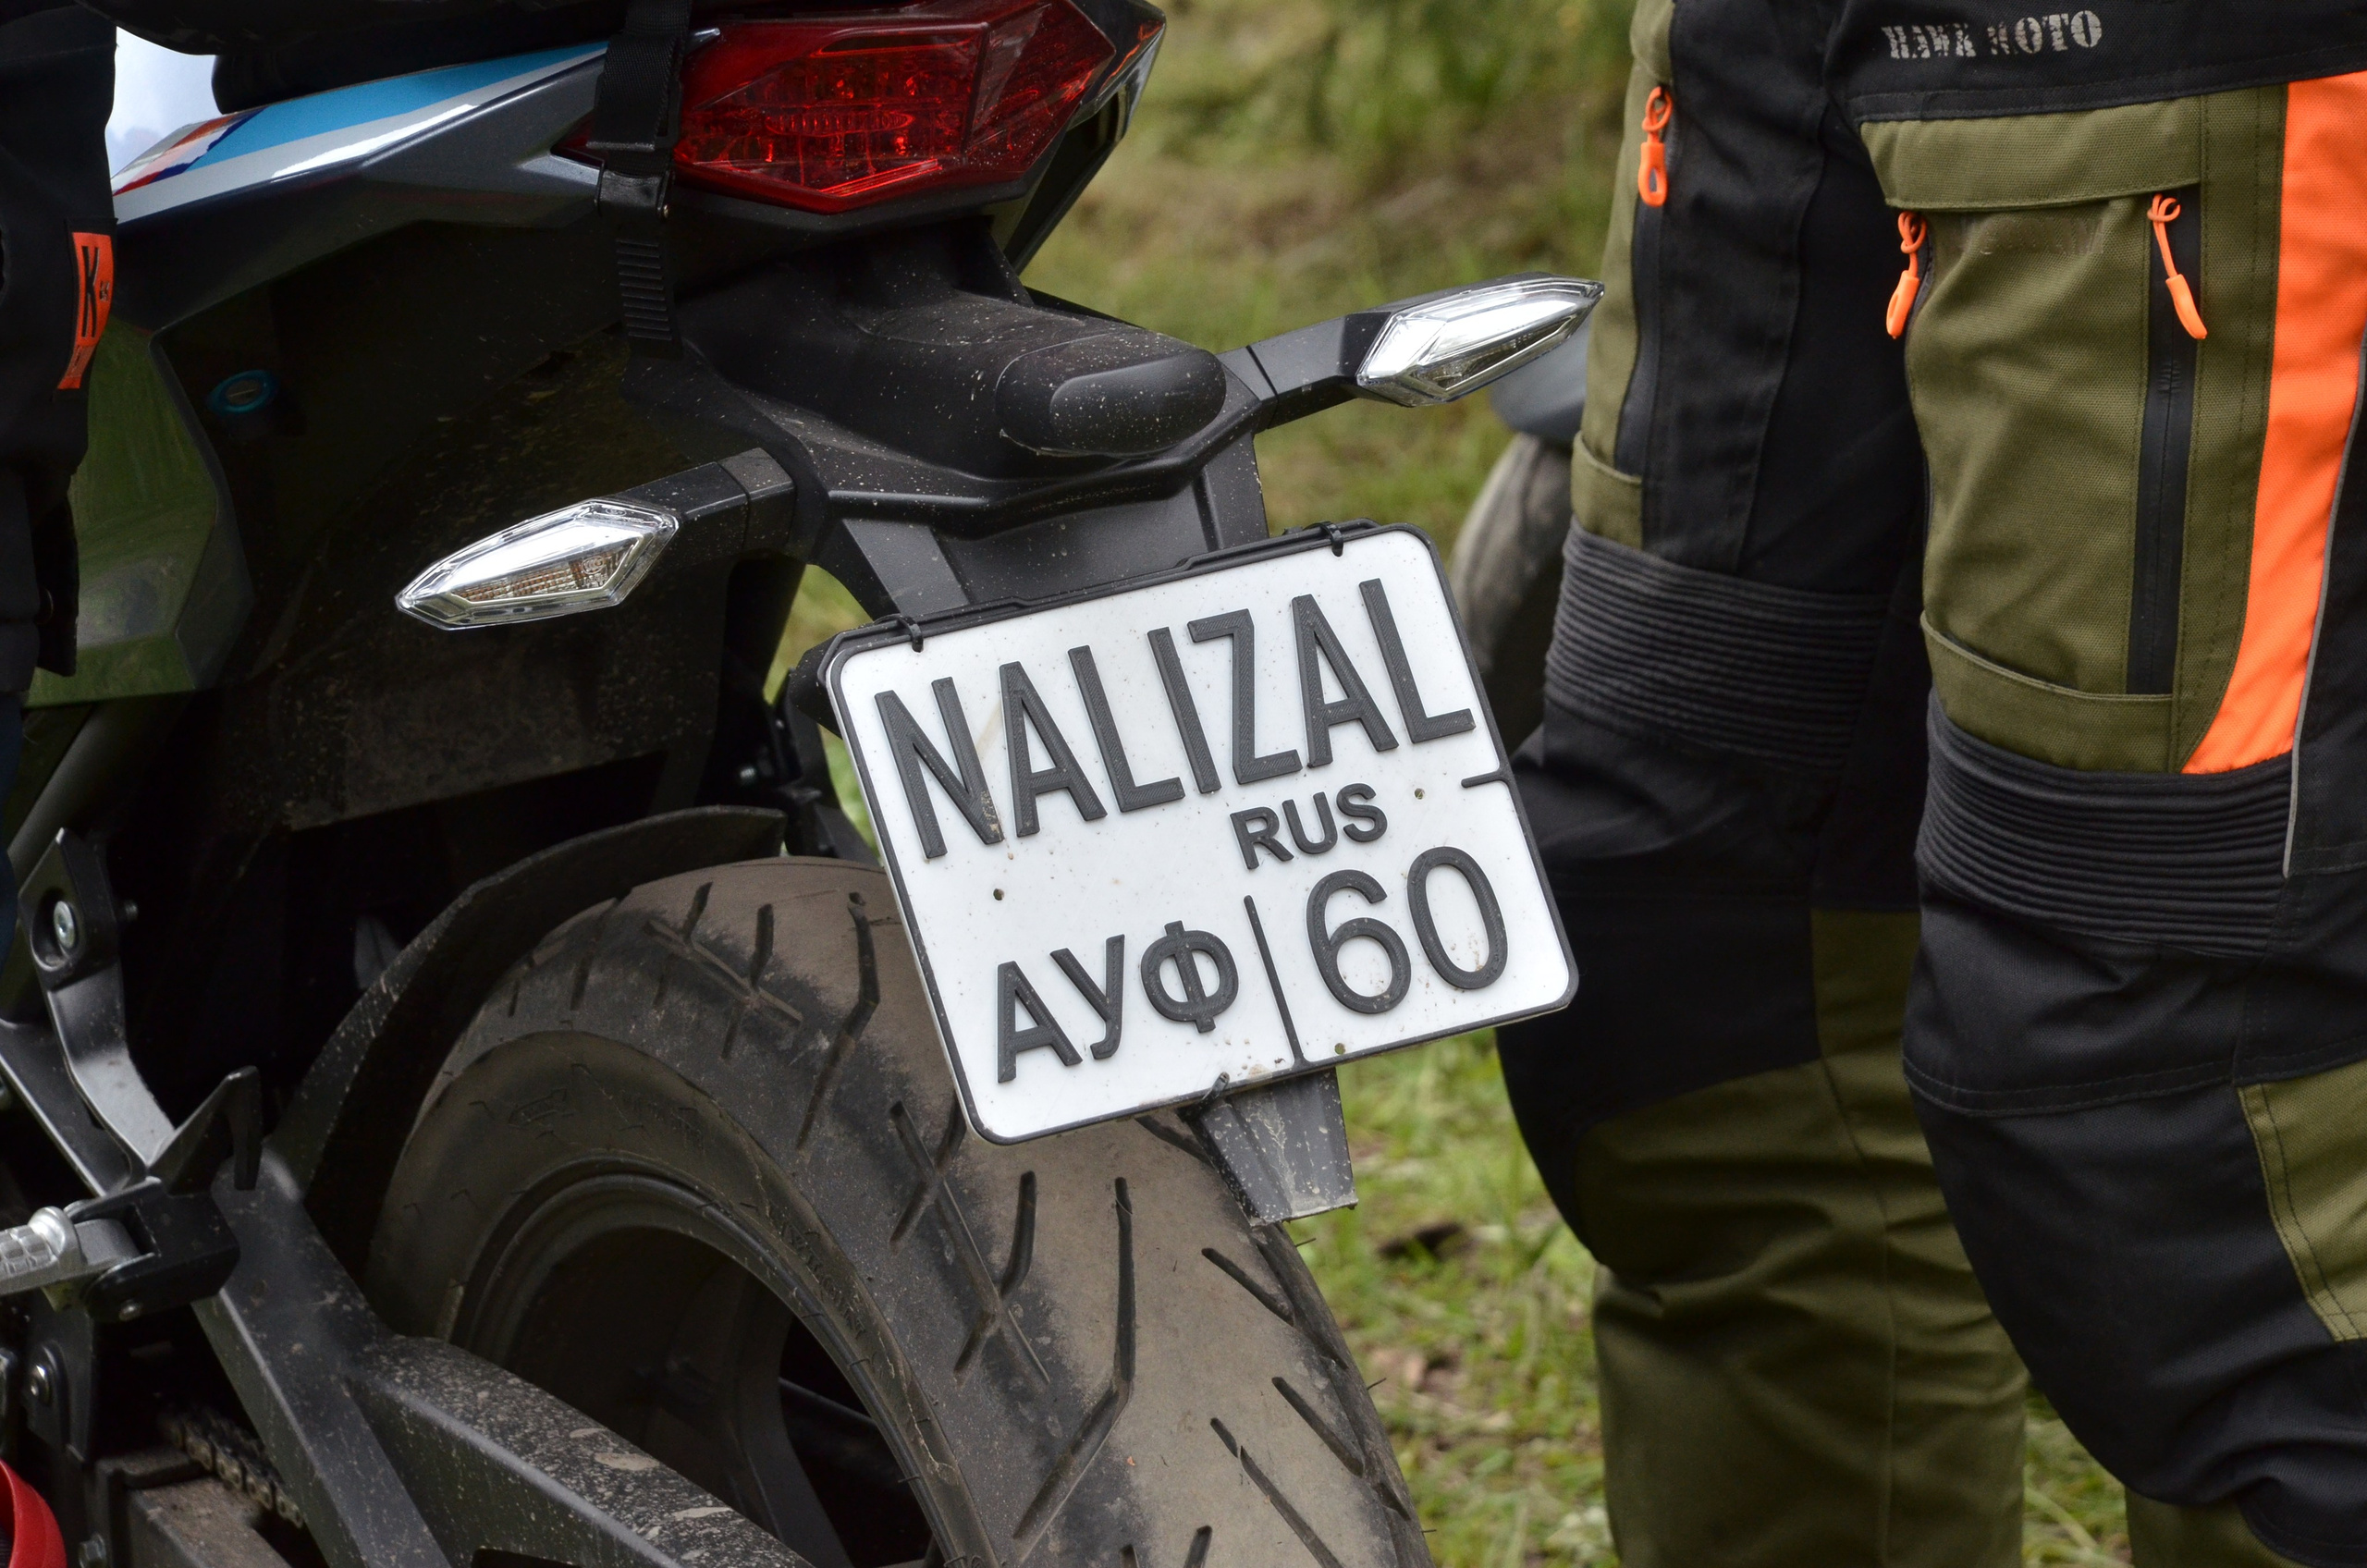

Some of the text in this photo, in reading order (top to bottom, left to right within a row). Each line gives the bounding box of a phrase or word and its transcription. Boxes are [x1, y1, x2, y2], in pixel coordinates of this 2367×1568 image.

[875, 578, 1476, 859] NALIZAL
[1231, 783, 1388, 870] RUS
[997, 920, 1239, 1084] АУФ
[1306, 846, 1509, 1014] 60
